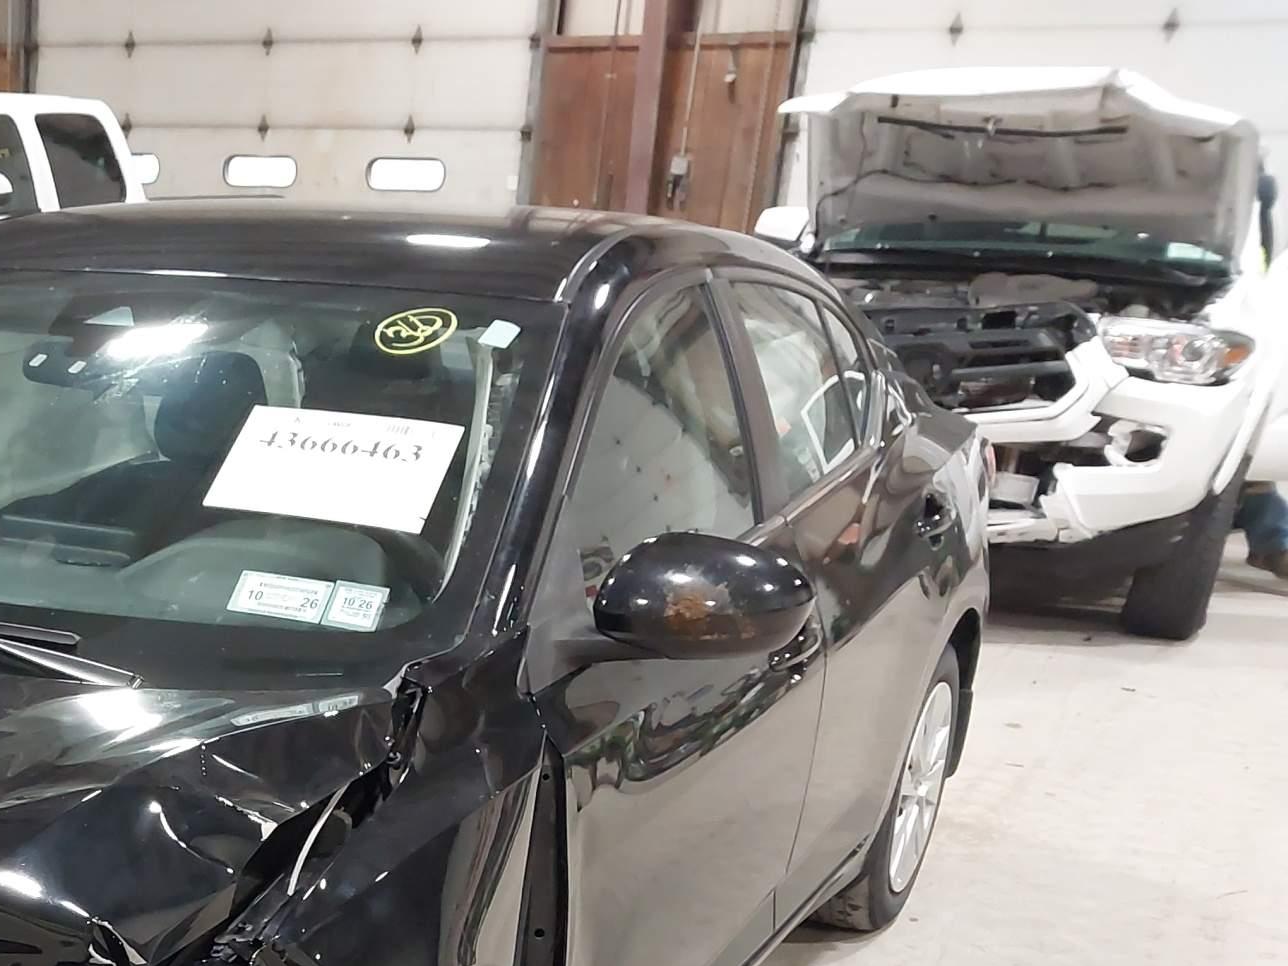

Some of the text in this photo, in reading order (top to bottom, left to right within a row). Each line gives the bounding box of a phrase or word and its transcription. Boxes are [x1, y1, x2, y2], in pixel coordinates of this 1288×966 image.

[248, 590, 264, 601] 10
[300, 597, 320, 610] 26
[343, 597, 373, 610] 10 26
